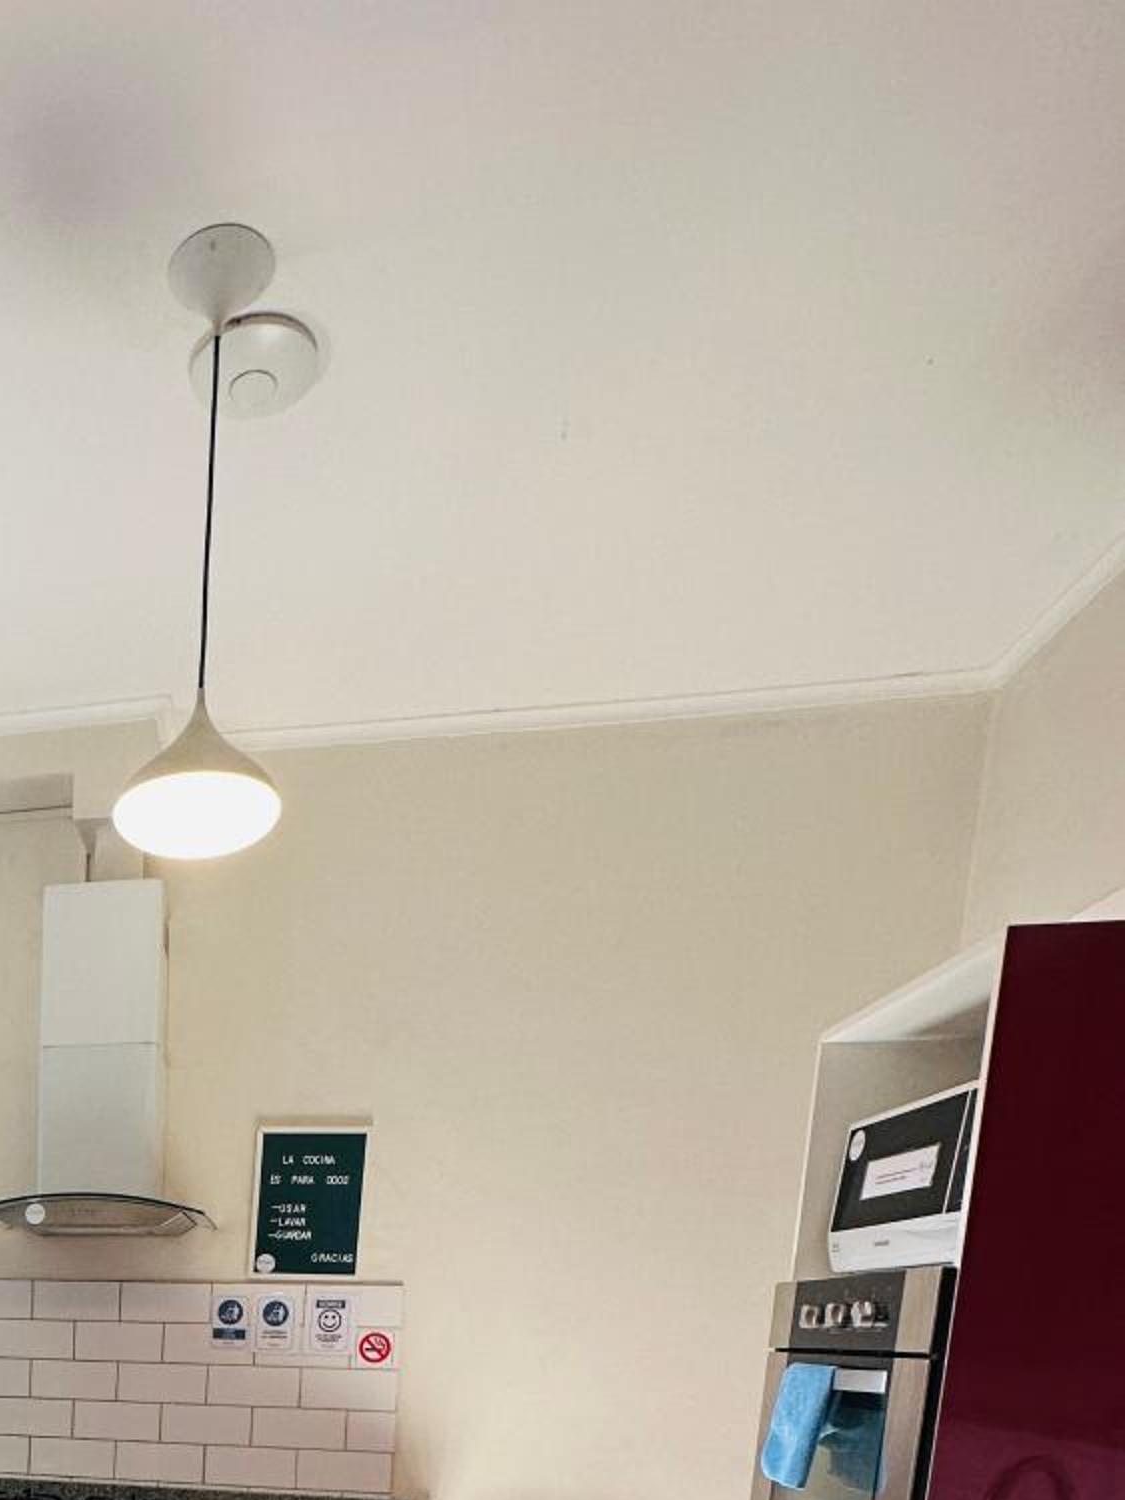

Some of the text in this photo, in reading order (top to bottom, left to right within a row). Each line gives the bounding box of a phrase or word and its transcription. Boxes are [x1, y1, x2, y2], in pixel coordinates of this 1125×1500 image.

[282, 1155, 336, 1165] LA COCINA
[270, 1175, 283, 1185] ES
[290, 1175, 315, 1185] PARA
[310, 1253, 354, 1263] GRACIAS
